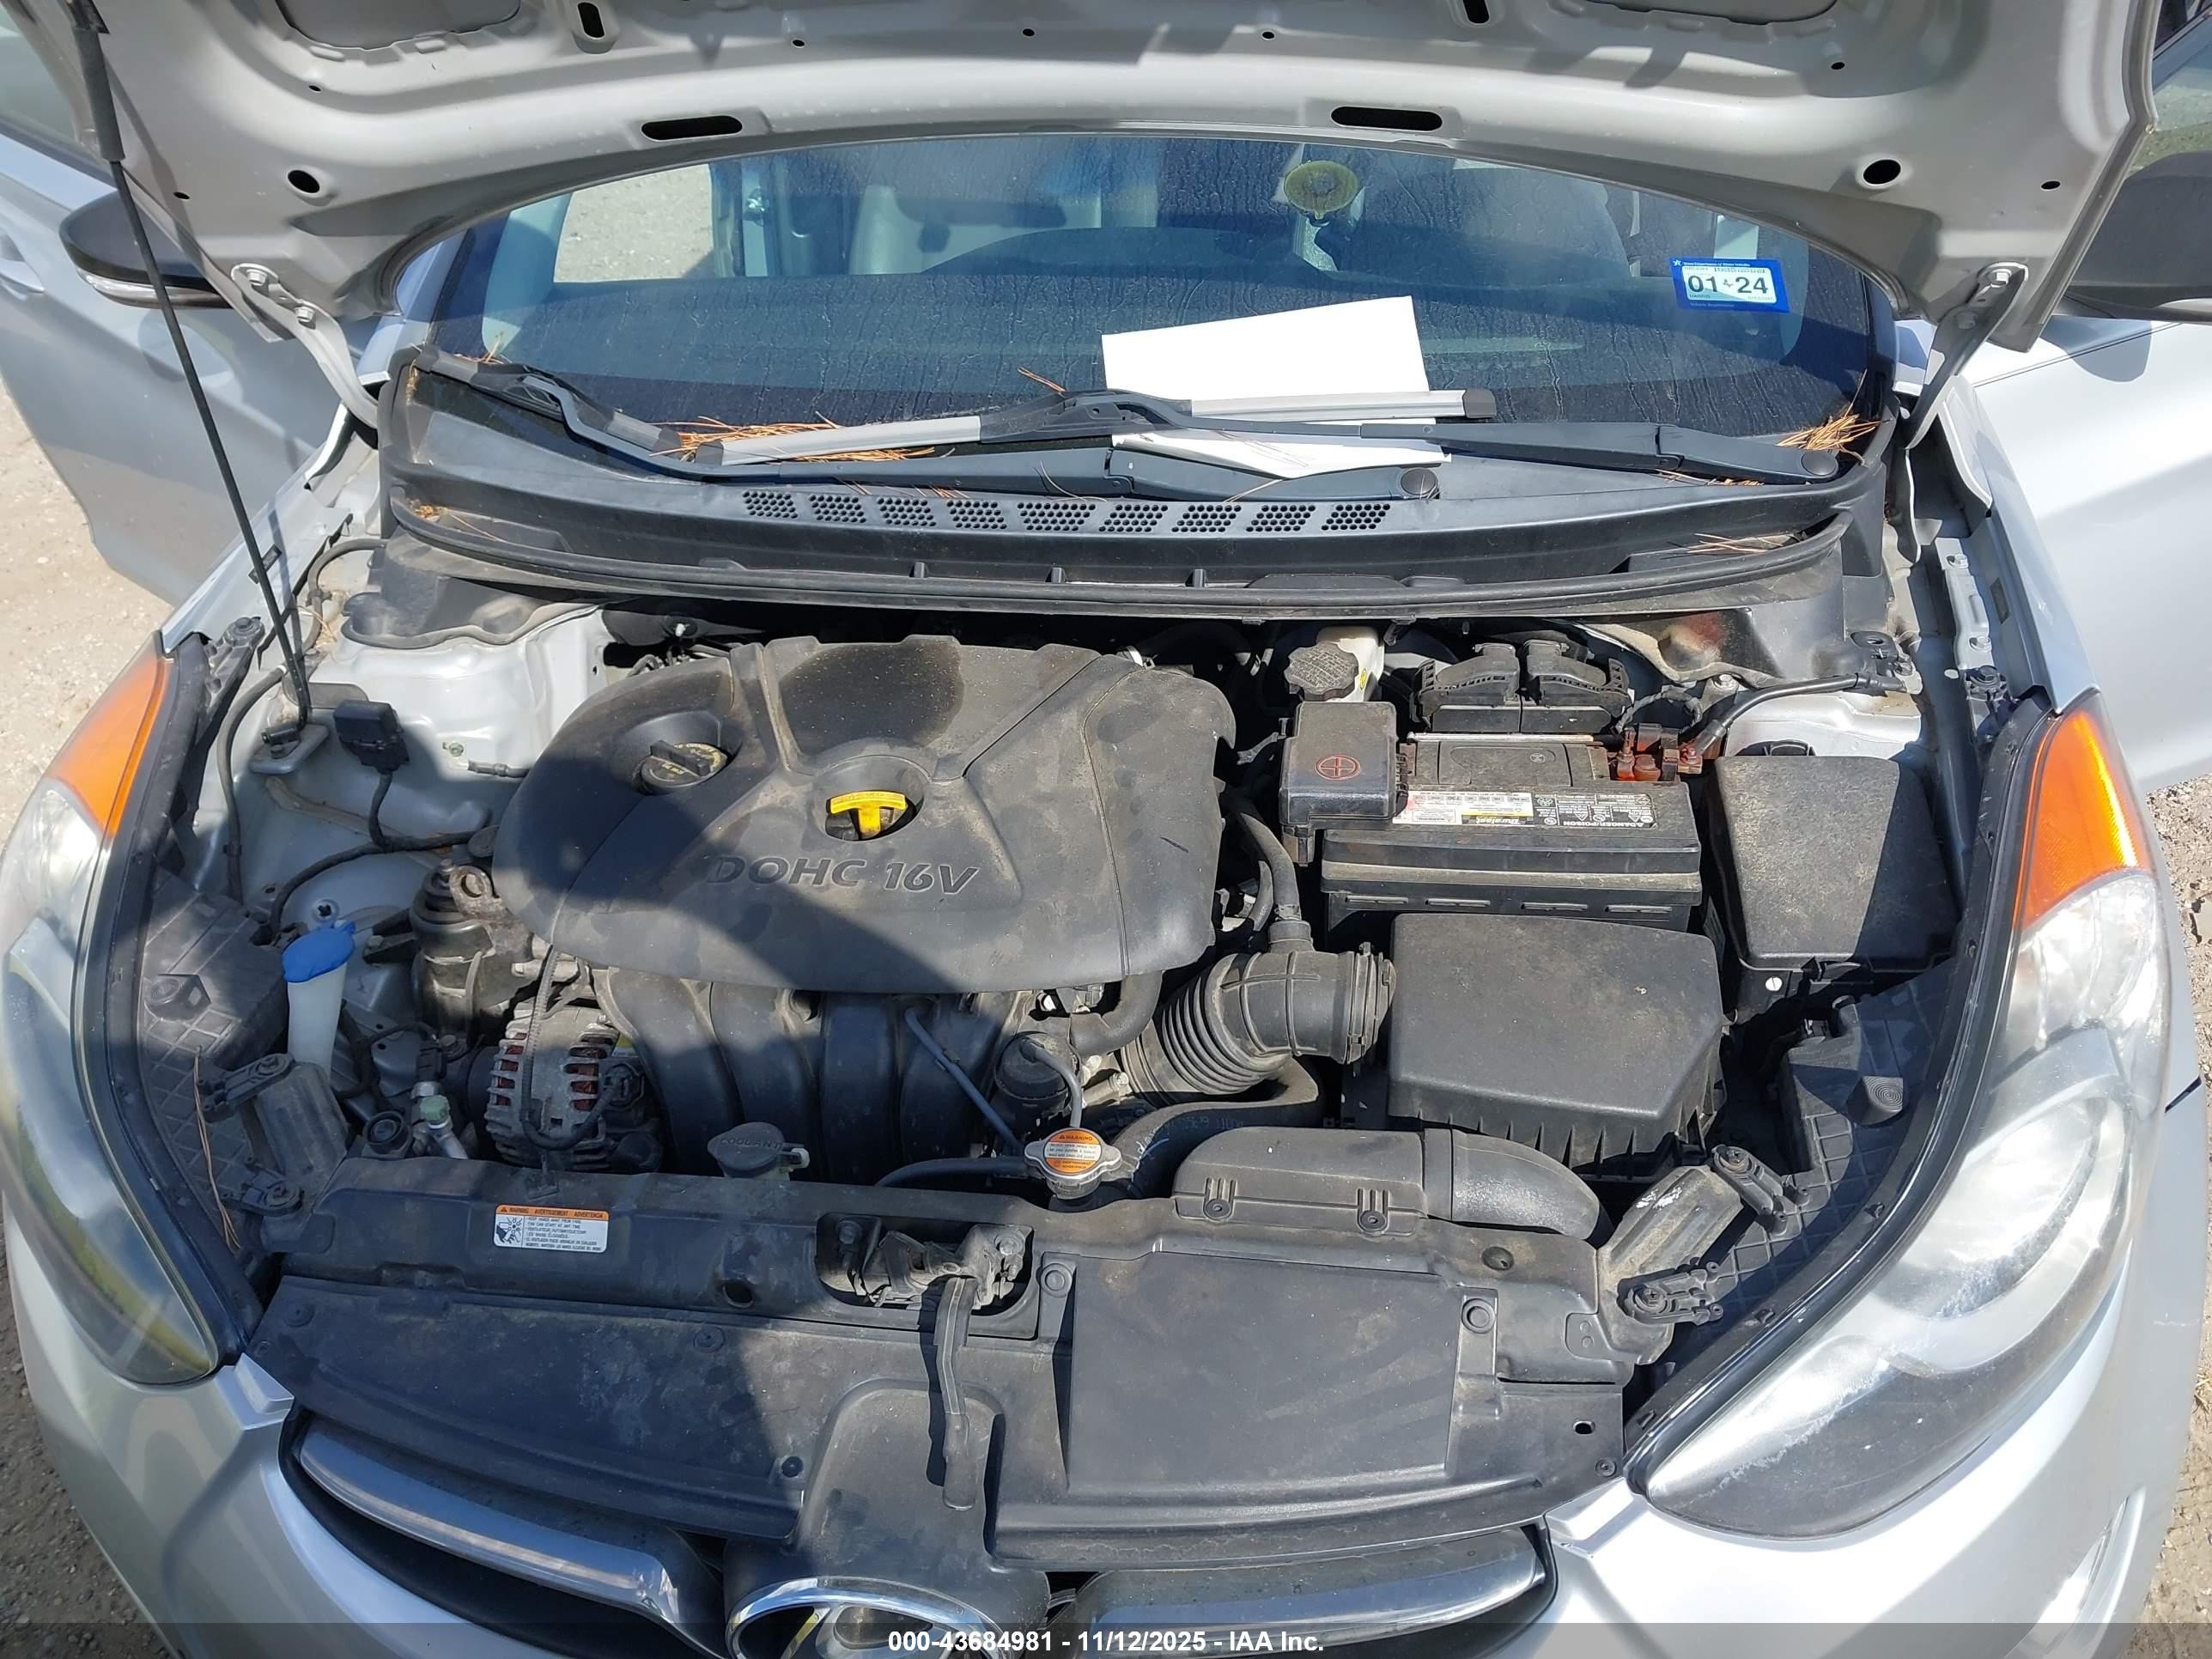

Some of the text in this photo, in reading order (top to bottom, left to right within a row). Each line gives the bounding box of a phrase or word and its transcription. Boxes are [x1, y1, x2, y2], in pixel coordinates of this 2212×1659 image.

[1688, 276, 1768, 294] 01 24
[706, 856, 981, 895] DOHC 16V
[720, 1139, 783, 1149] COOLANT
